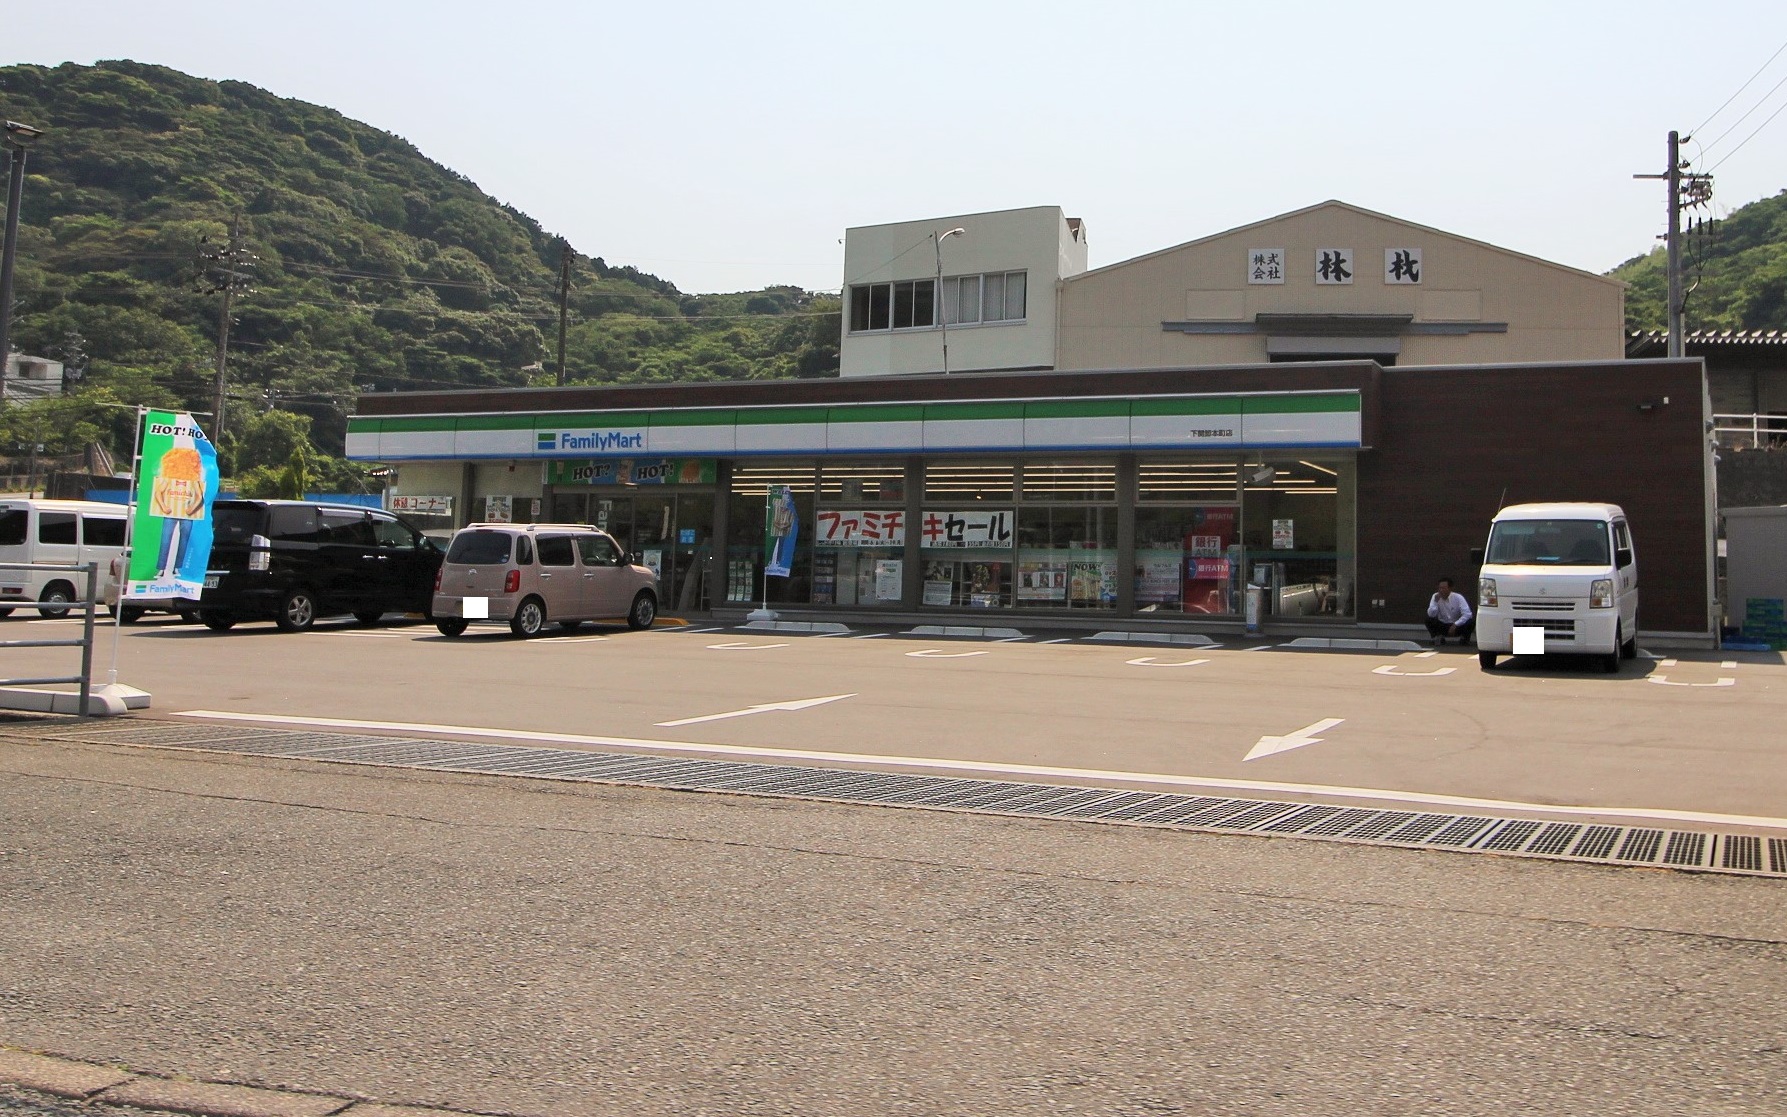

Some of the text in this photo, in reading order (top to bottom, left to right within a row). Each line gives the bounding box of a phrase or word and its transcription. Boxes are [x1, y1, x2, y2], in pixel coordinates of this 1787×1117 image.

[1253, 253, 1280, 266] 株式
[1253, 266, 1281, 280] 会社
[150, 424, 208, 441] HOT! HO
[561, 432, 642, 451] FamilyMart
[573, 464, 674, 480] HOT? HOT!
[393, 497, 446, 509] 休憩コーナー
[1195, 536, 1218, 548] 銀行
[1198, 564, 1229, 572] 銀行ATM
[150, 584, 194, 594] FamilyMart
